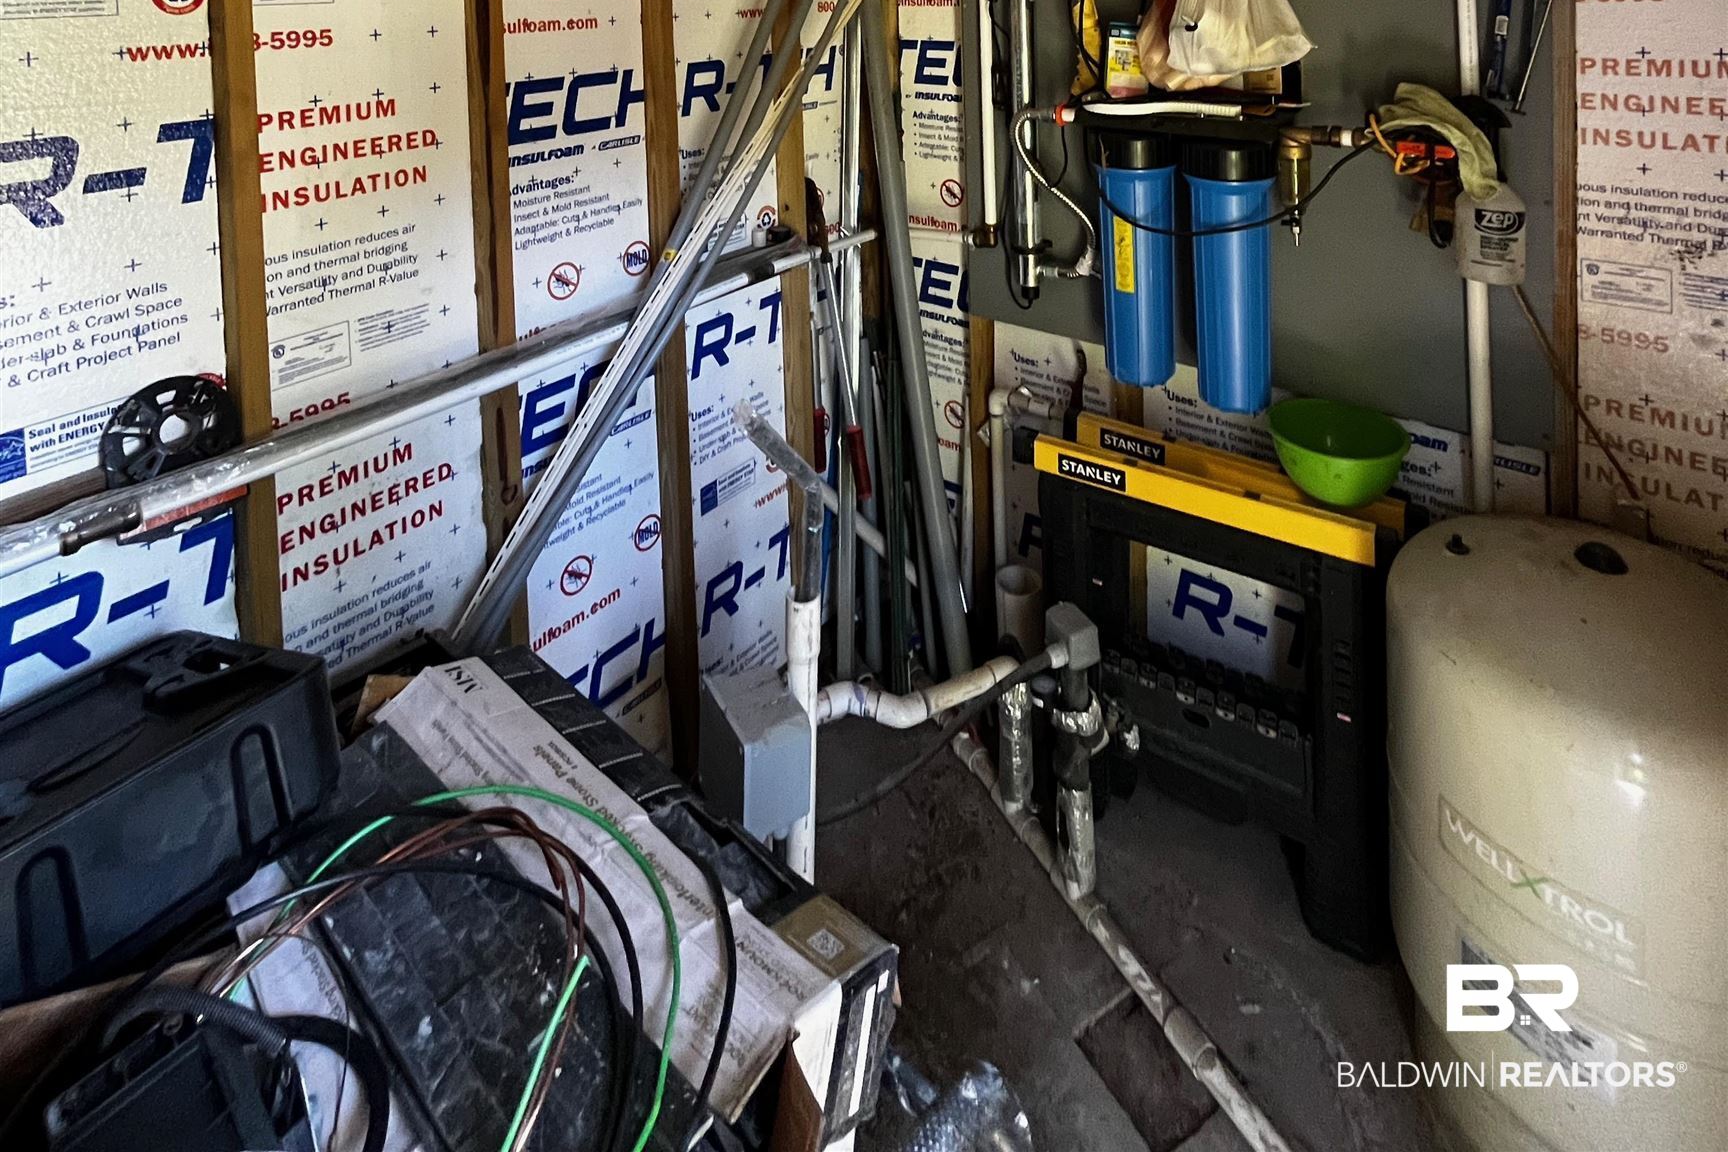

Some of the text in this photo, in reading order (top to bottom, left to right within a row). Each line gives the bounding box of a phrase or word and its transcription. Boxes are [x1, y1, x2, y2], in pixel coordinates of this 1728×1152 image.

[257, 98, 397, 133] PREMIUM
[259, 129, 437, 174] ENGINEERED
[260, 165, 428, 213] INSULATION
[513, 185, 590, 209] Moisture Resistant
[1610, 183, 1678, 200] insulation
[514, 193, 610, 223] Insect Mold Resistant
[1604, 200, 1689, 218] and thermal
[292, 223, 416, 260] insulation reduces air
[287, 241, 408, 278] and thermal bridging
[341, 268, 363, 281] and
[367, 254, 418, 274] Durability
[59, 281, 168, 316] Exterior Walls
[328, 279, 375, 299] Thermal
[379, 268, 419, 287] R-Value
[85, 298, 183, 328] Crawl Space
[91, 313, 188, 346] Foundations
[27, 332, 181, 382] Craft Project Panel
[28, 416, 80, 439] Seal and
[30, 437, 56, 453] with
[1103, 432, 1162, 460] STANLEY
[277, 442, 414, 515] PREMIUM
[1061, 458, 1122, 488] STANLEY
[280, 461, 455, 555] ENGINEERED
[281, 499, 445, 592] INSULATION
[311, 560, 431, 629] insulation reduces air
